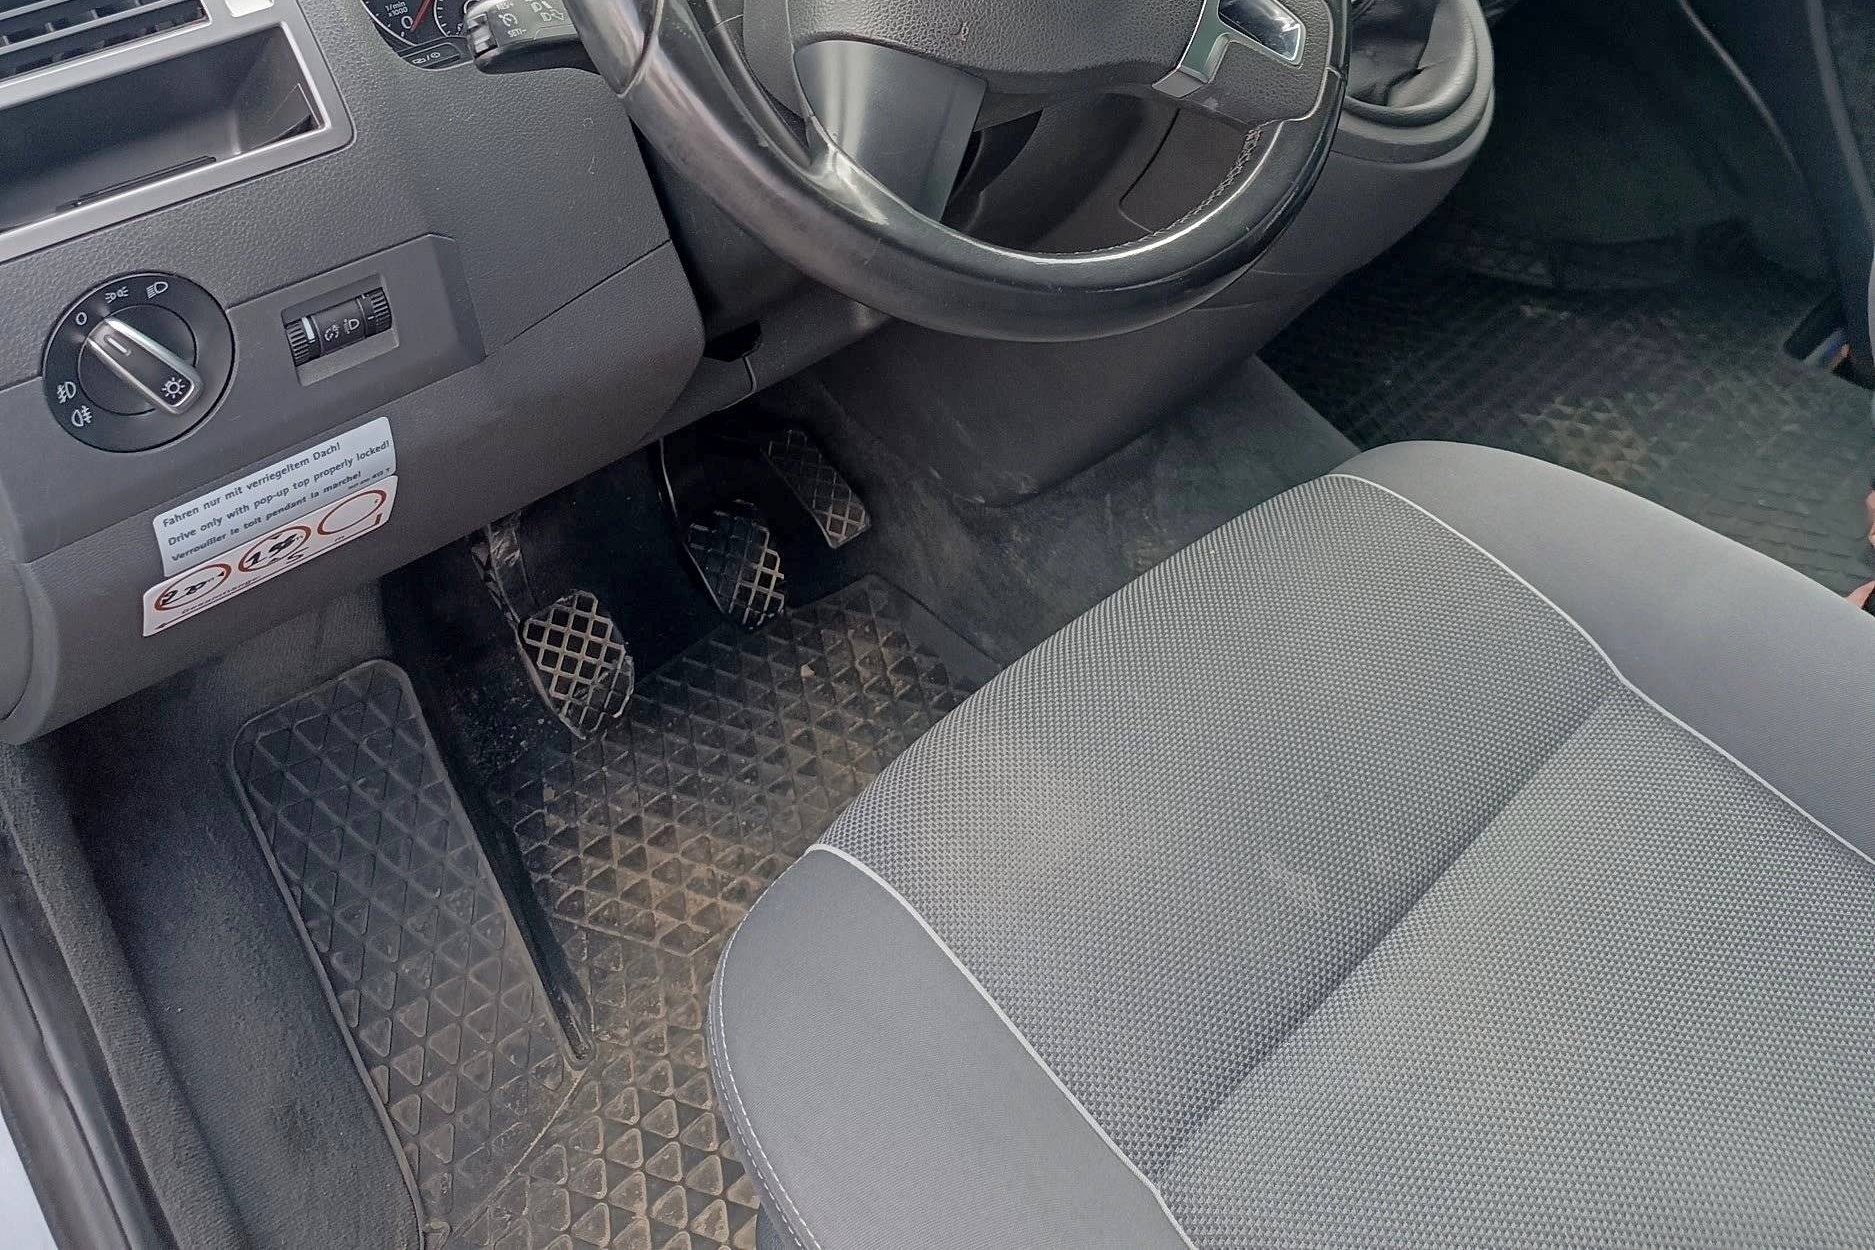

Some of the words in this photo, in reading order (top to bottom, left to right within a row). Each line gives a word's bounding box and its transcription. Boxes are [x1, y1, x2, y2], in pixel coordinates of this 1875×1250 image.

[385, 1, 406, 12] 1/min
[401, 16, 413, 29] 0
[163, 507, 199, 527] Fahren
[203, 497, 220, 510] nur
[225, 486, 243, 500] mit
[246, 458, 310, 490] verriegeltem
[313, 442, 341, 461] Dach!
[168, 529, 197, 546] Drive
[200, 517, 222, 531] only
[226, 504, 250, 519] with
[254, 486, 290, 509] pop-up
[292, 477, 310, 490] top
[313, 457, 354, 483] properly
[356, 440, 390, 462] locked!
[230, 527, 240, 535] le
[243, 517, 262, 529] toit
[265, 495, 307, 521] pendant
[310, 491, 320, 499] la
[323, 471, 361, 493] marche!
